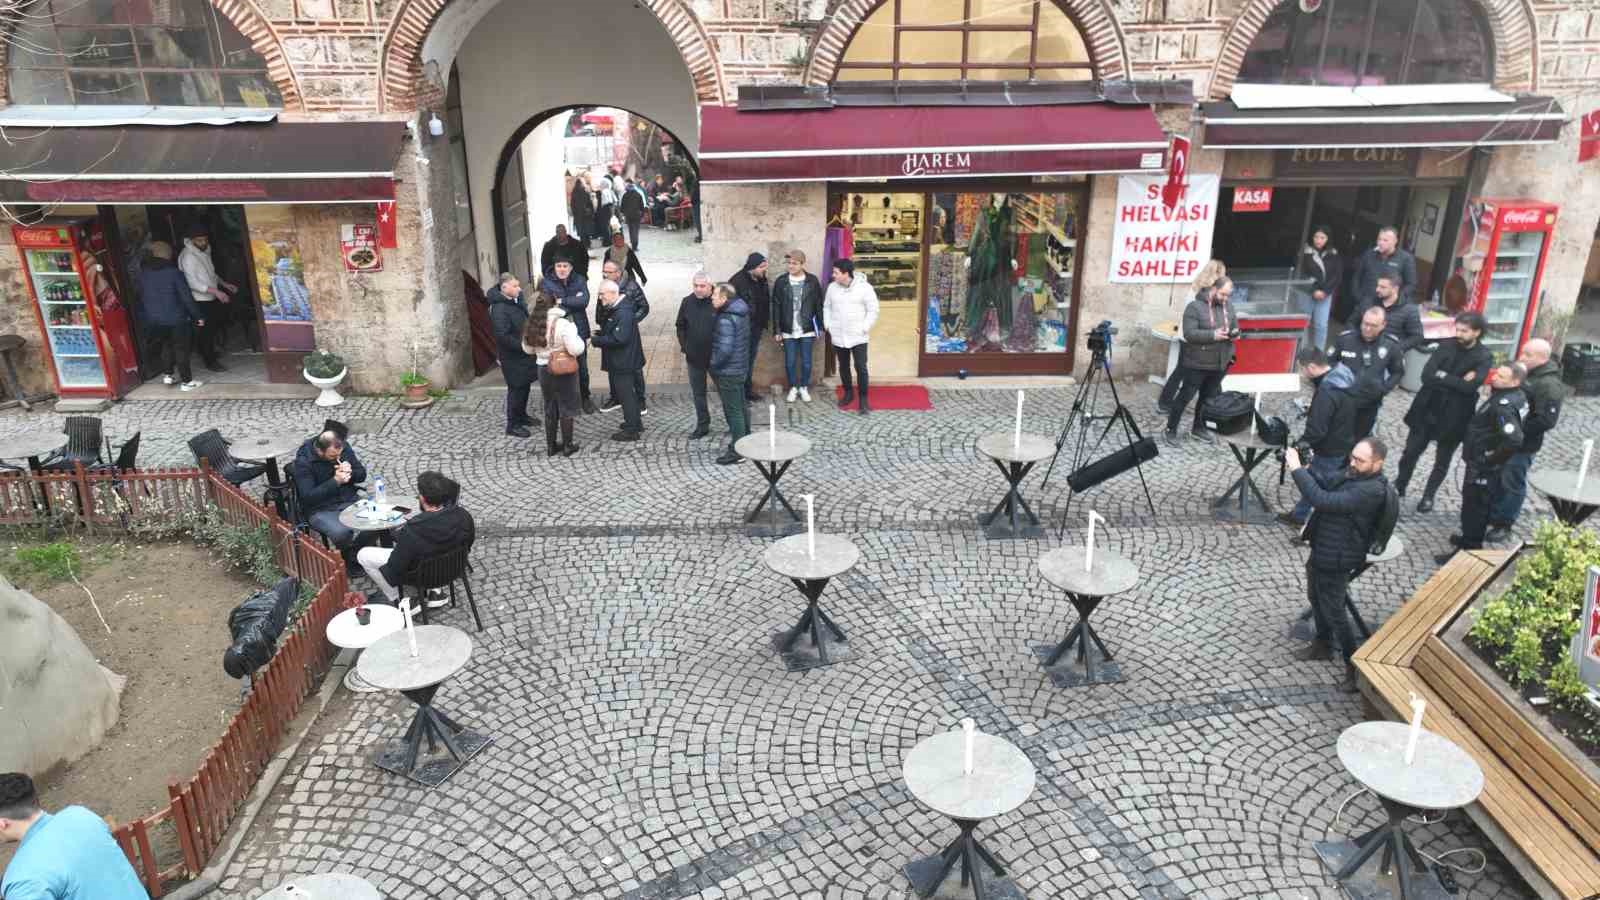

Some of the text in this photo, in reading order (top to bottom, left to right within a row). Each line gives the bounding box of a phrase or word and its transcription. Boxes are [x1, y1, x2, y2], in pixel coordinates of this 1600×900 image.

[902, 152, 971, 176] HAREM
[1147, 184, 1189, 200] ST
[1233, 190, 1271, 204] KASA
[1121, 204, 1208, 222] HELVASI
[1125, 231, 1198, 252] HAKİKİ
[1118, 259, 1199, 277] SAHLEP
